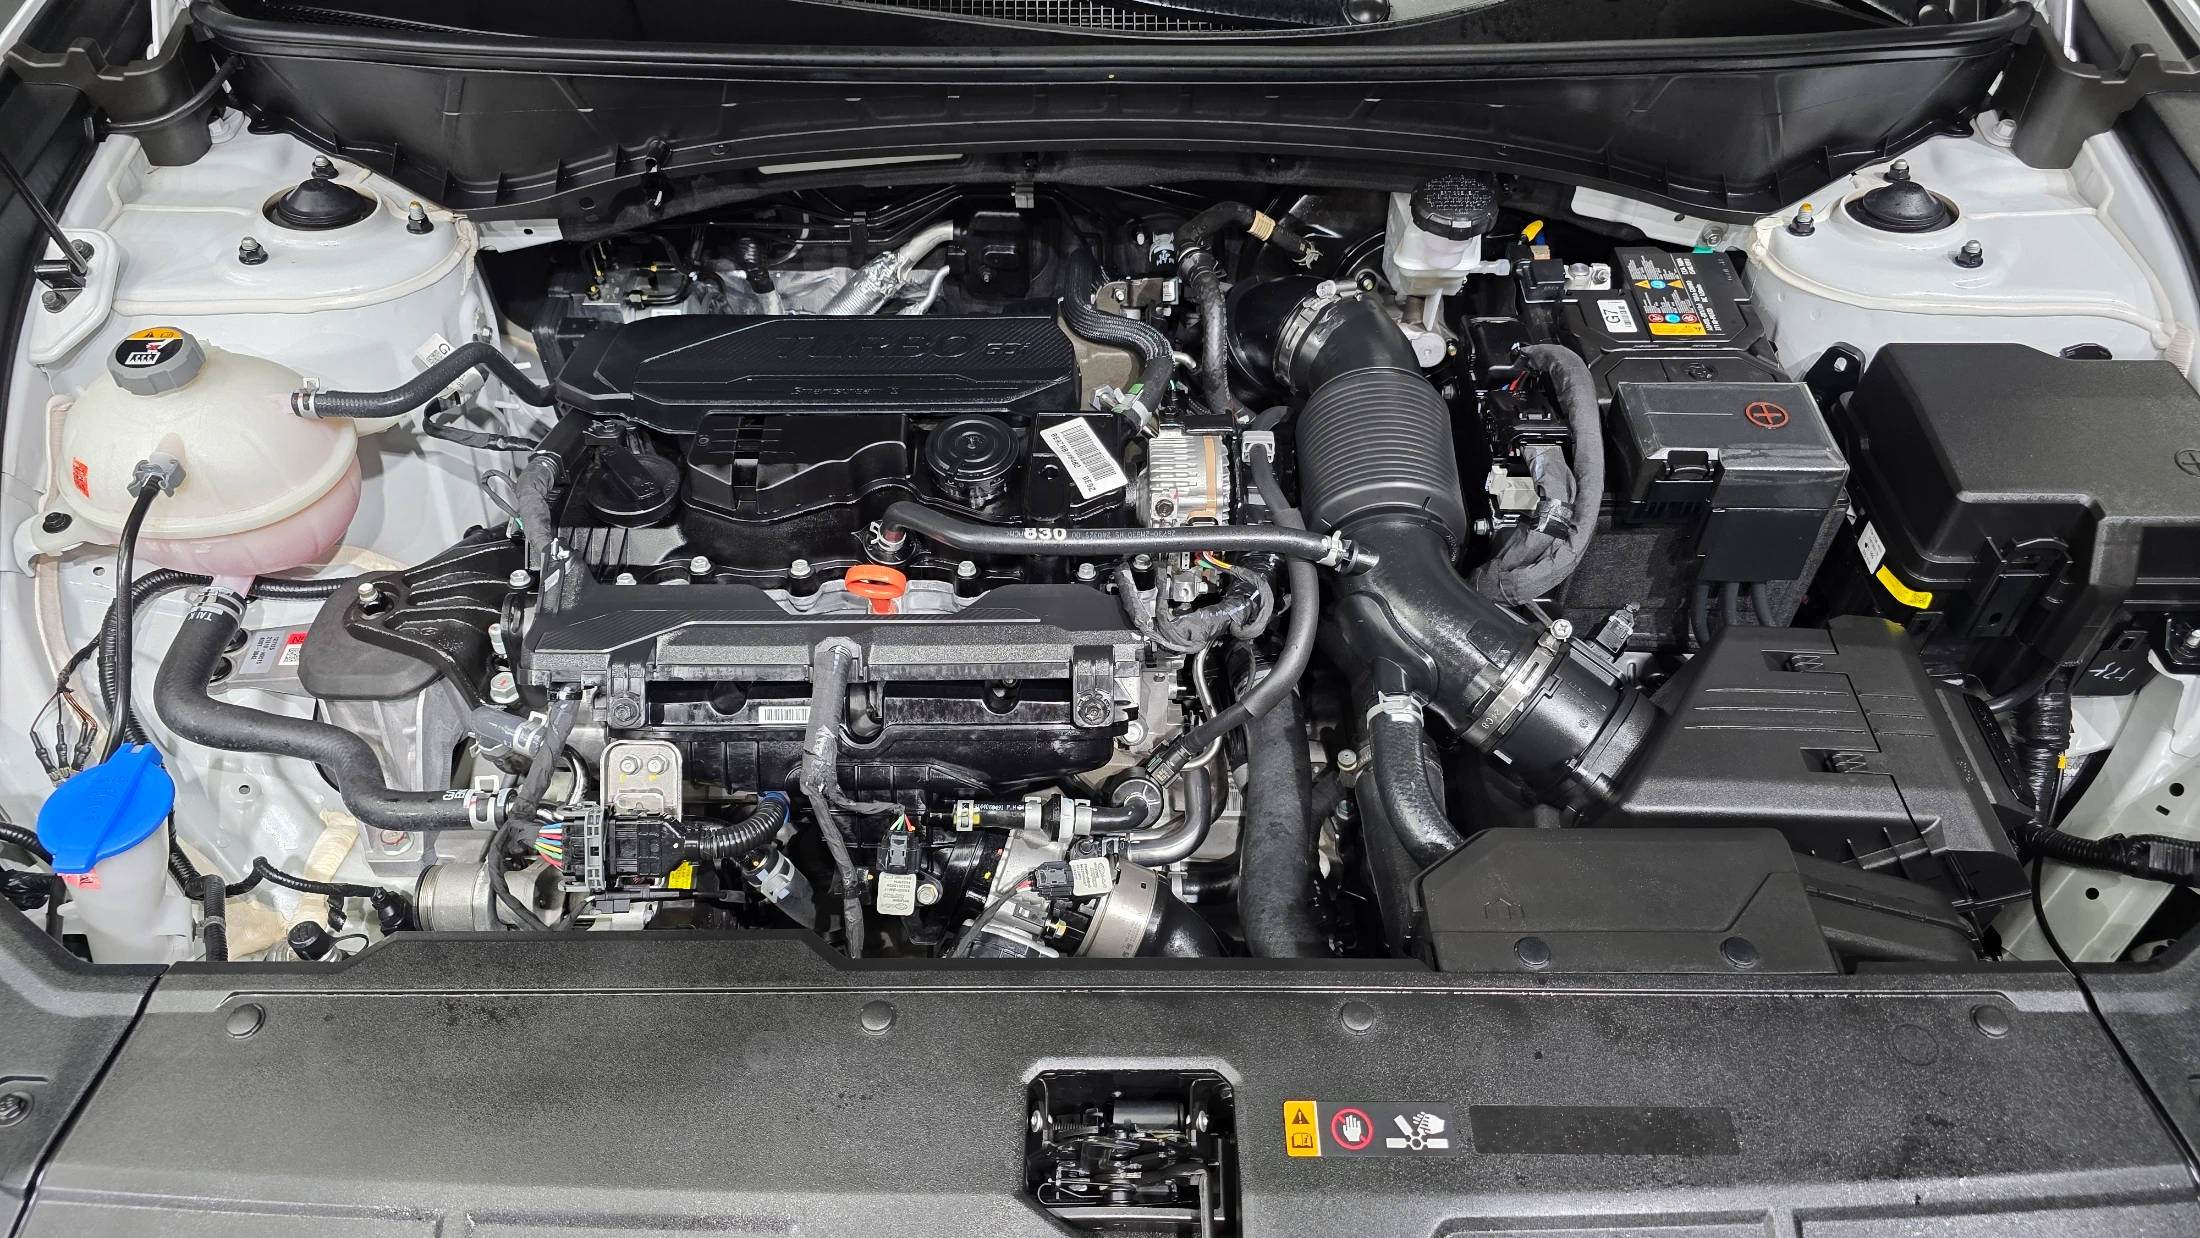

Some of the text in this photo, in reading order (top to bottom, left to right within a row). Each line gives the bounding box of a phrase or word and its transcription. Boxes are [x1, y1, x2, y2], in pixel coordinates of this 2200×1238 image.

[1603, 309, 1621, 323] G7
[1024, 527, 1067, 540] 830
[1481, 708, 1503, 730] 24C8
